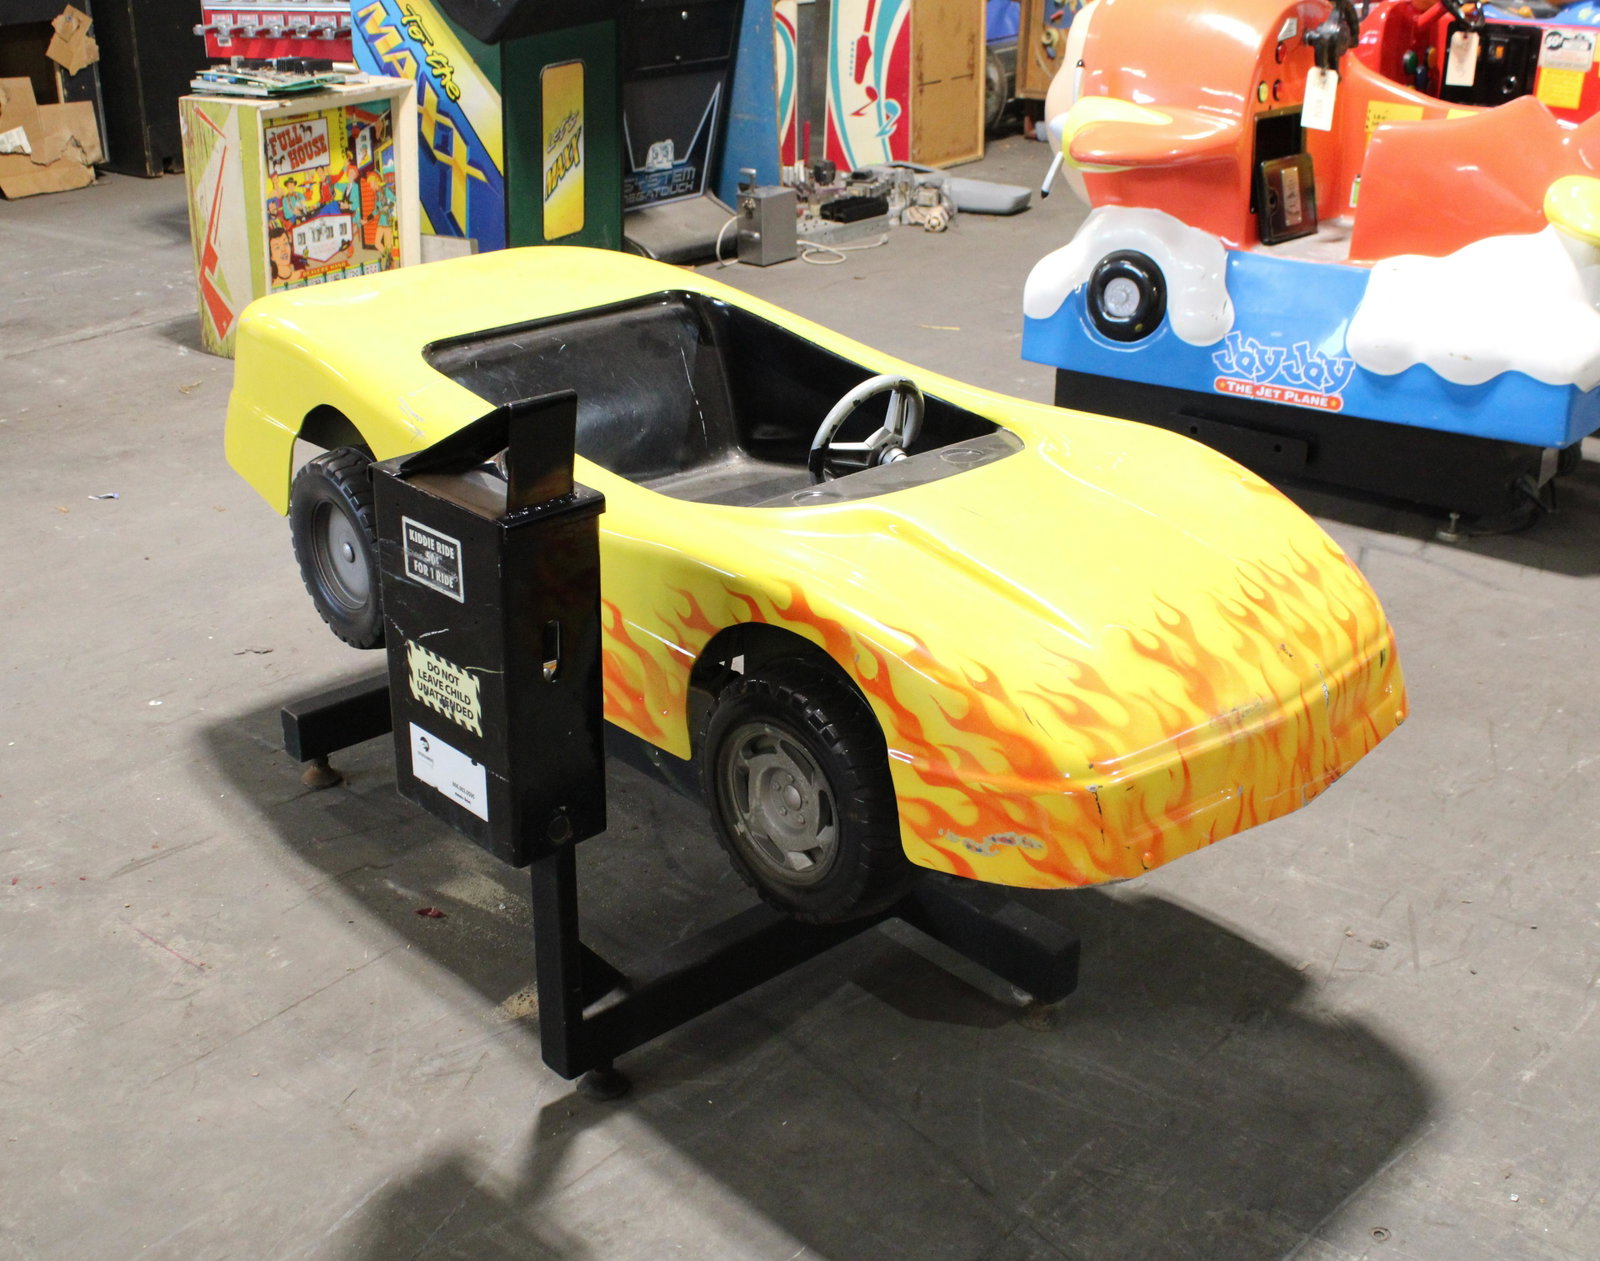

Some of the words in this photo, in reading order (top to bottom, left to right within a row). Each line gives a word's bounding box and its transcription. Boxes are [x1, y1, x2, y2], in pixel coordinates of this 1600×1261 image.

[269, 125, 303, 157] FULL
[287, 133, 328, 170] HOUSE
[545, 125, 582, 202] MAXX
[1284, 390, 1329, 407] PLANE
[408, 528, 435, 551] KIDDIE
[436, 541, 455, 560] RIDE
[413, 559, 429, 576] FOR
[430, 567, 434, 579] 1
[435, 569, 454, 588] RIDE
[417, 668, 444, 691] LEAVE
[445, 684, 471, 706] CHILD
[427, 661, 440, 676] DO
[441, 669, 460, 687] NOT
[417, 680, 474, 720] UNATTENDED
